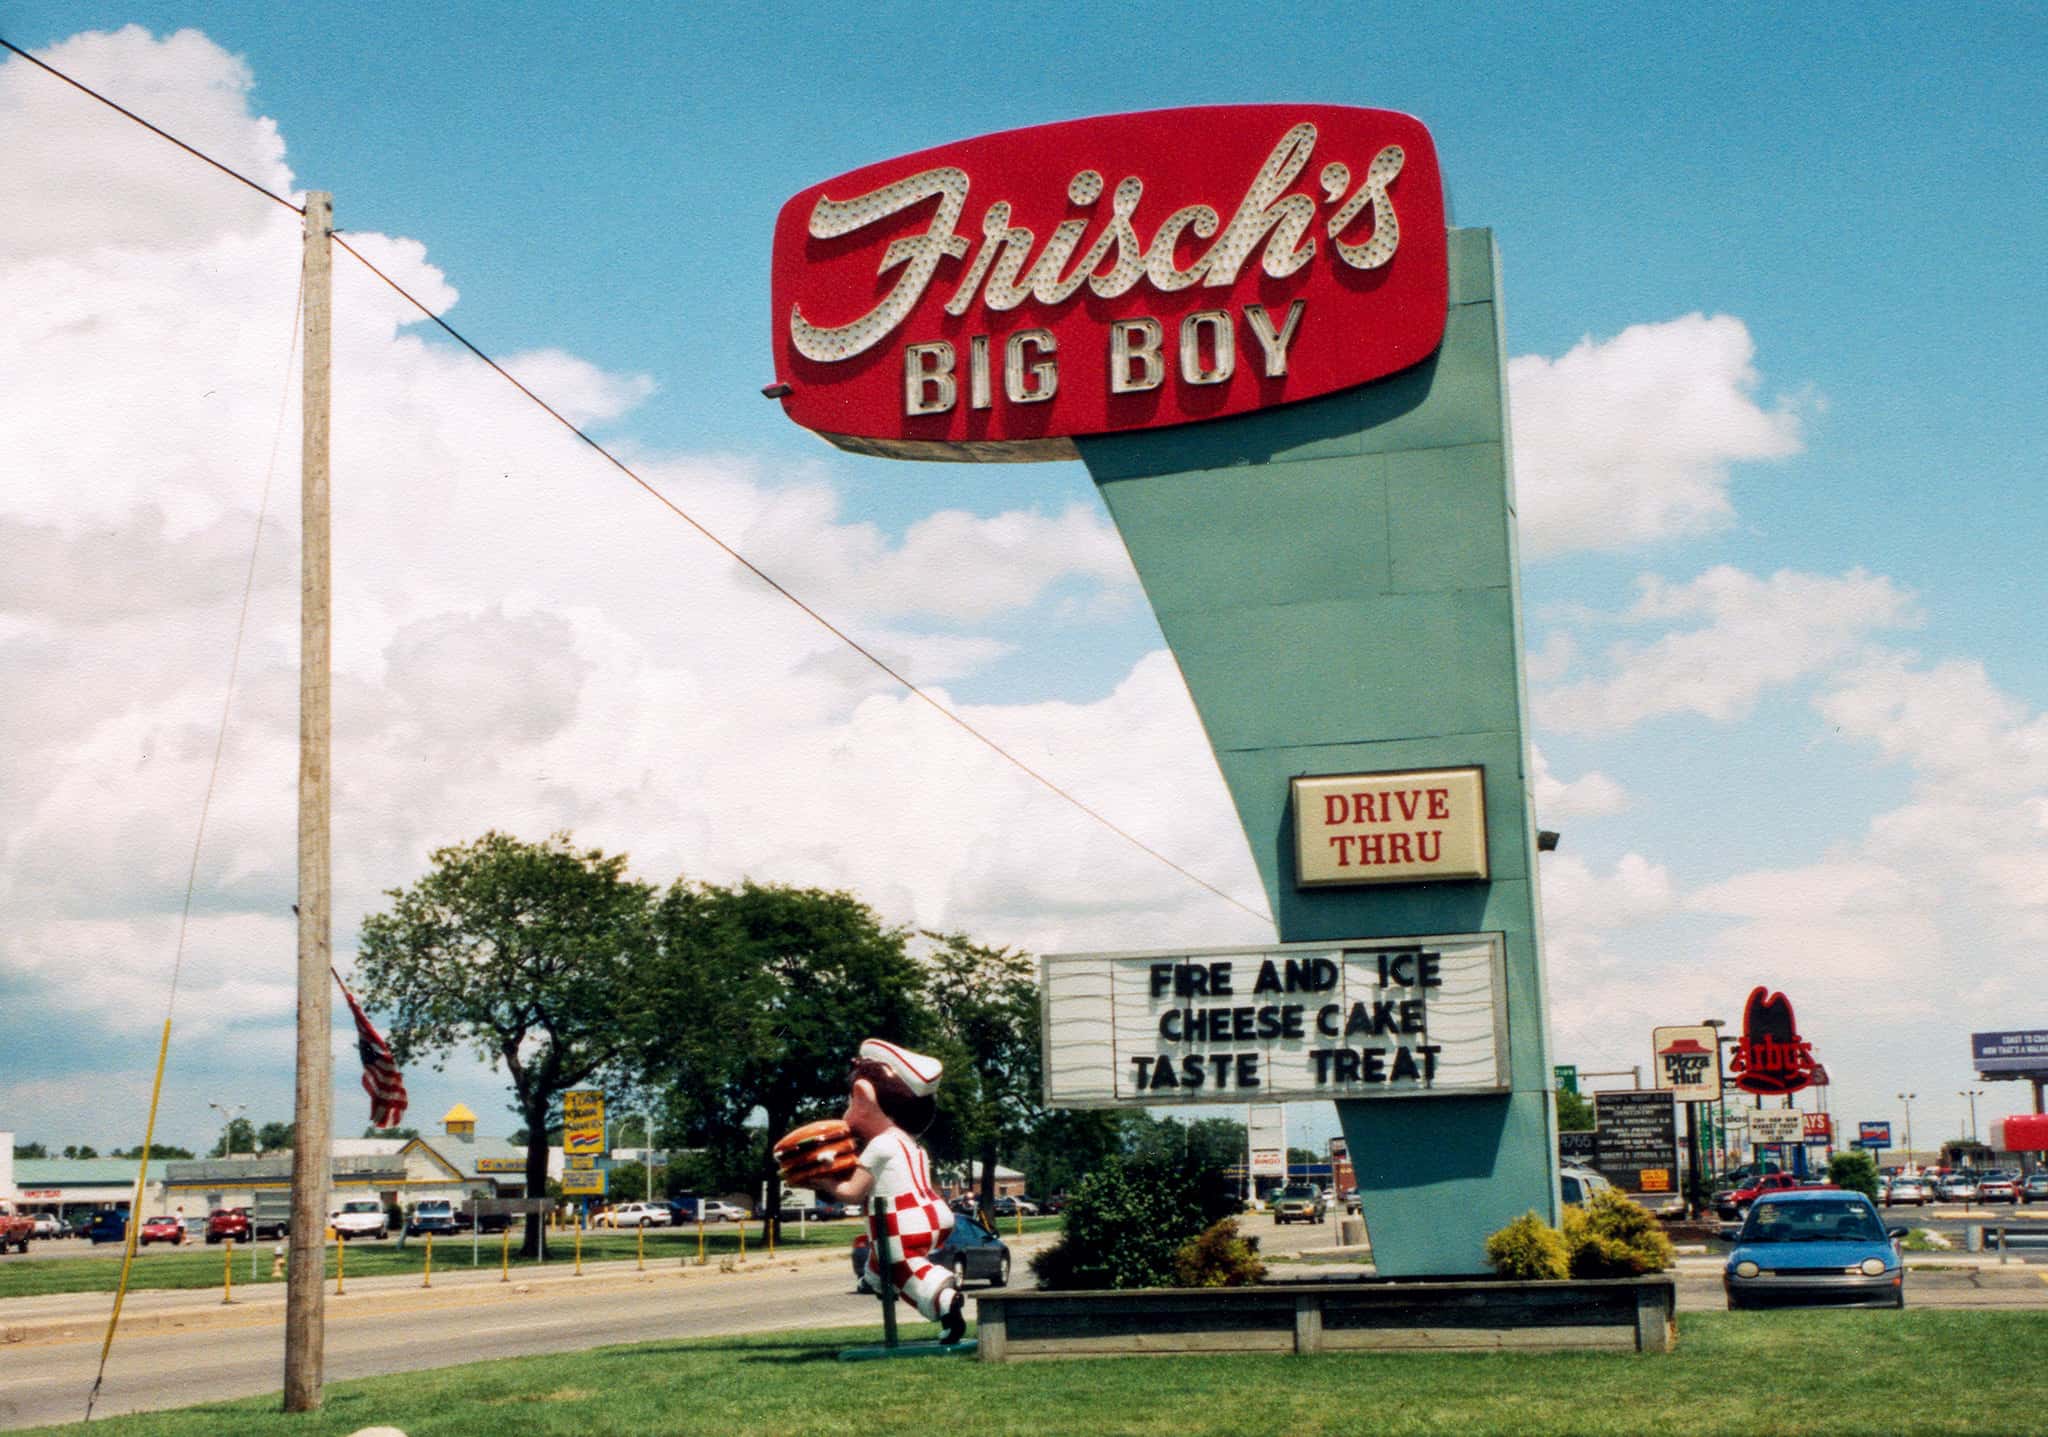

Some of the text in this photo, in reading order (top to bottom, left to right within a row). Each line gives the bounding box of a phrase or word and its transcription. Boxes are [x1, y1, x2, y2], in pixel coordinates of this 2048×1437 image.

[791, 122, 1404, 362] Frisch's
[905, 298, 1306, 415] BIG BOY
[1324, 788, 1450, 825] DRIVE
[1330, 831, 1443, 866] THRU
[1149, 952, 1442, 998] FIRE AND ICE
[1159, 999, 1425, 1042] CHEESE CAKE
[1132, 1045, 1442, 1090] TASTE TREAT
[1664, 1054, 1710, 1071] Pizza
[1666, 1068, 1703, 1084] Hut
[1729, 1034, 1816, 1079] Arby's
